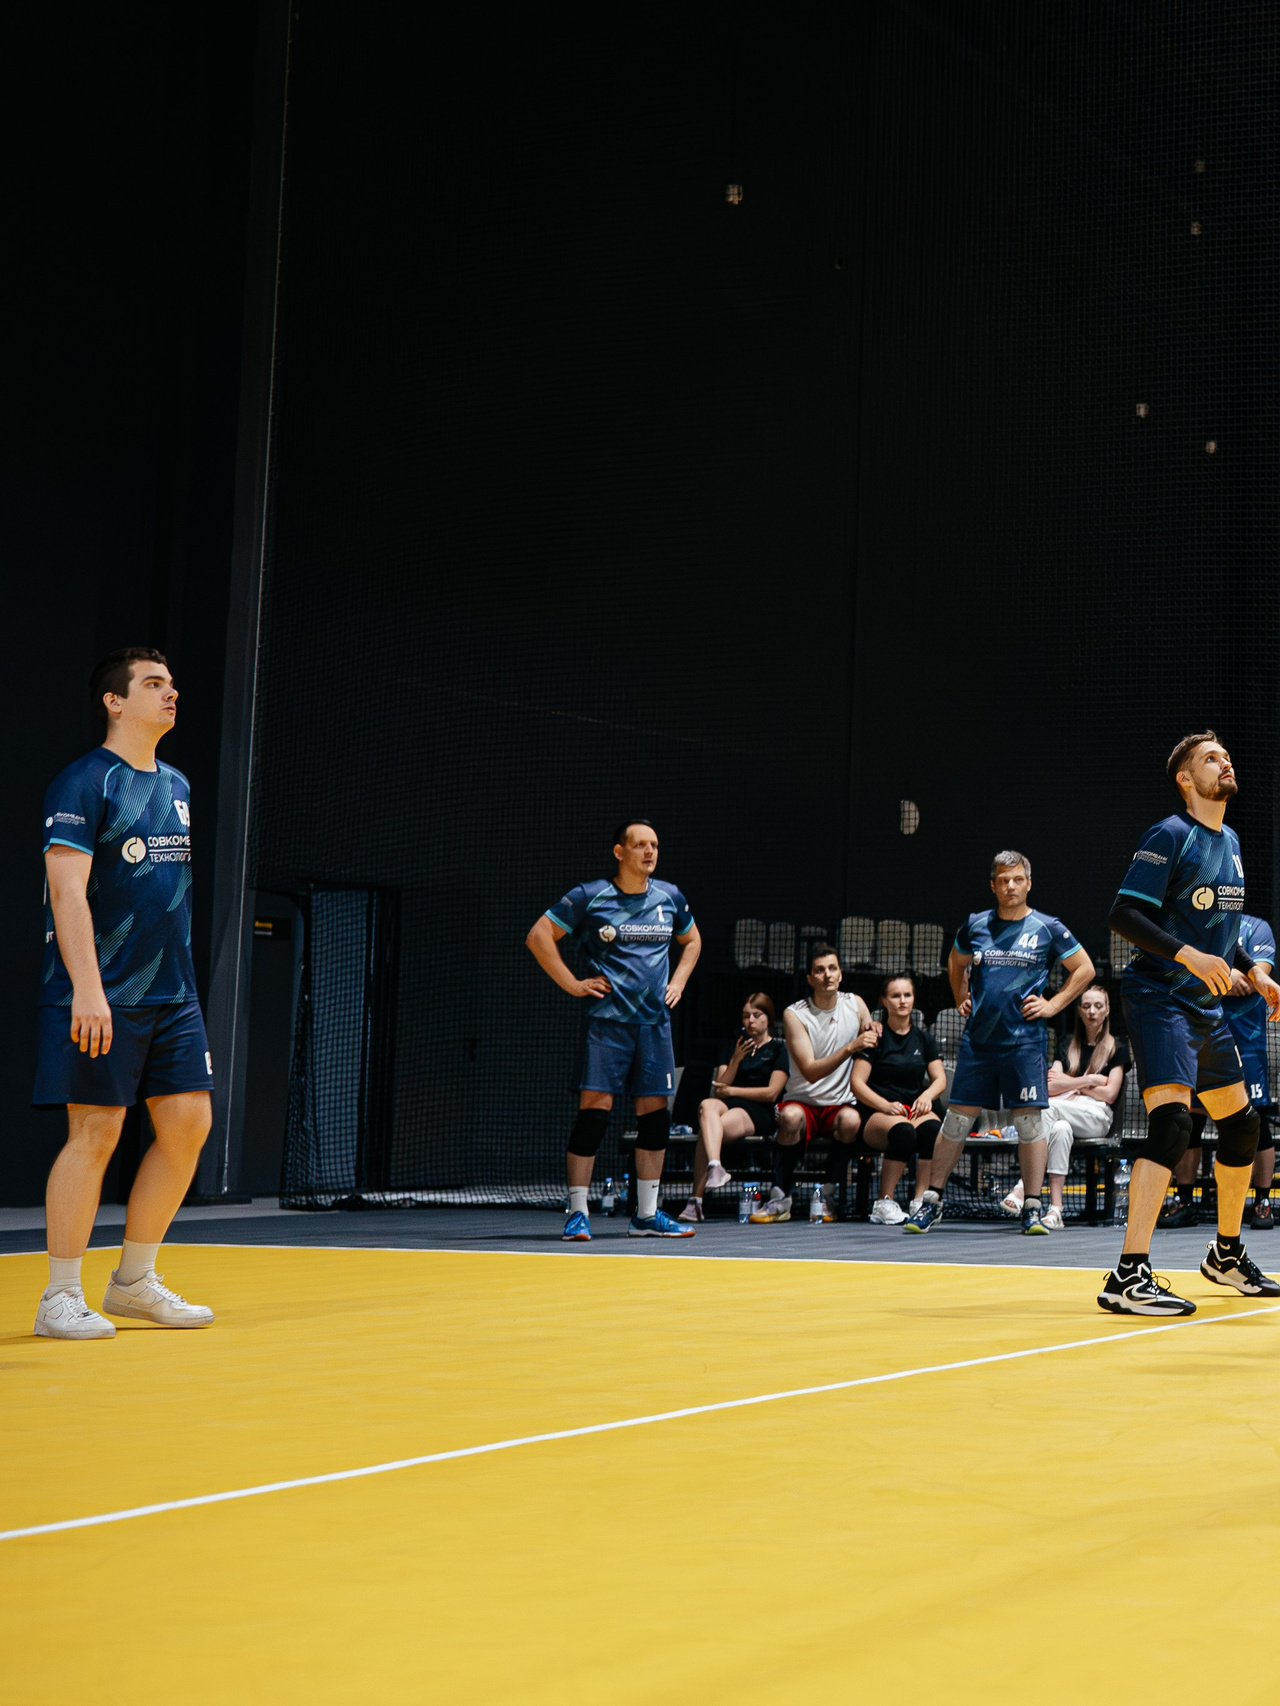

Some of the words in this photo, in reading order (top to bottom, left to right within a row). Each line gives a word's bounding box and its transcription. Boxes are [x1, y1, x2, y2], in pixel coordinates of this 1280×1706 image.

[656, 904, 665, 923] 1
[1018, 932, 1039, 950] 44
[666, 1072, 672, 1089] 1
[1020, 1085, 1038, 1101] 44
[1250, 1083, 1263, 1099] 15
